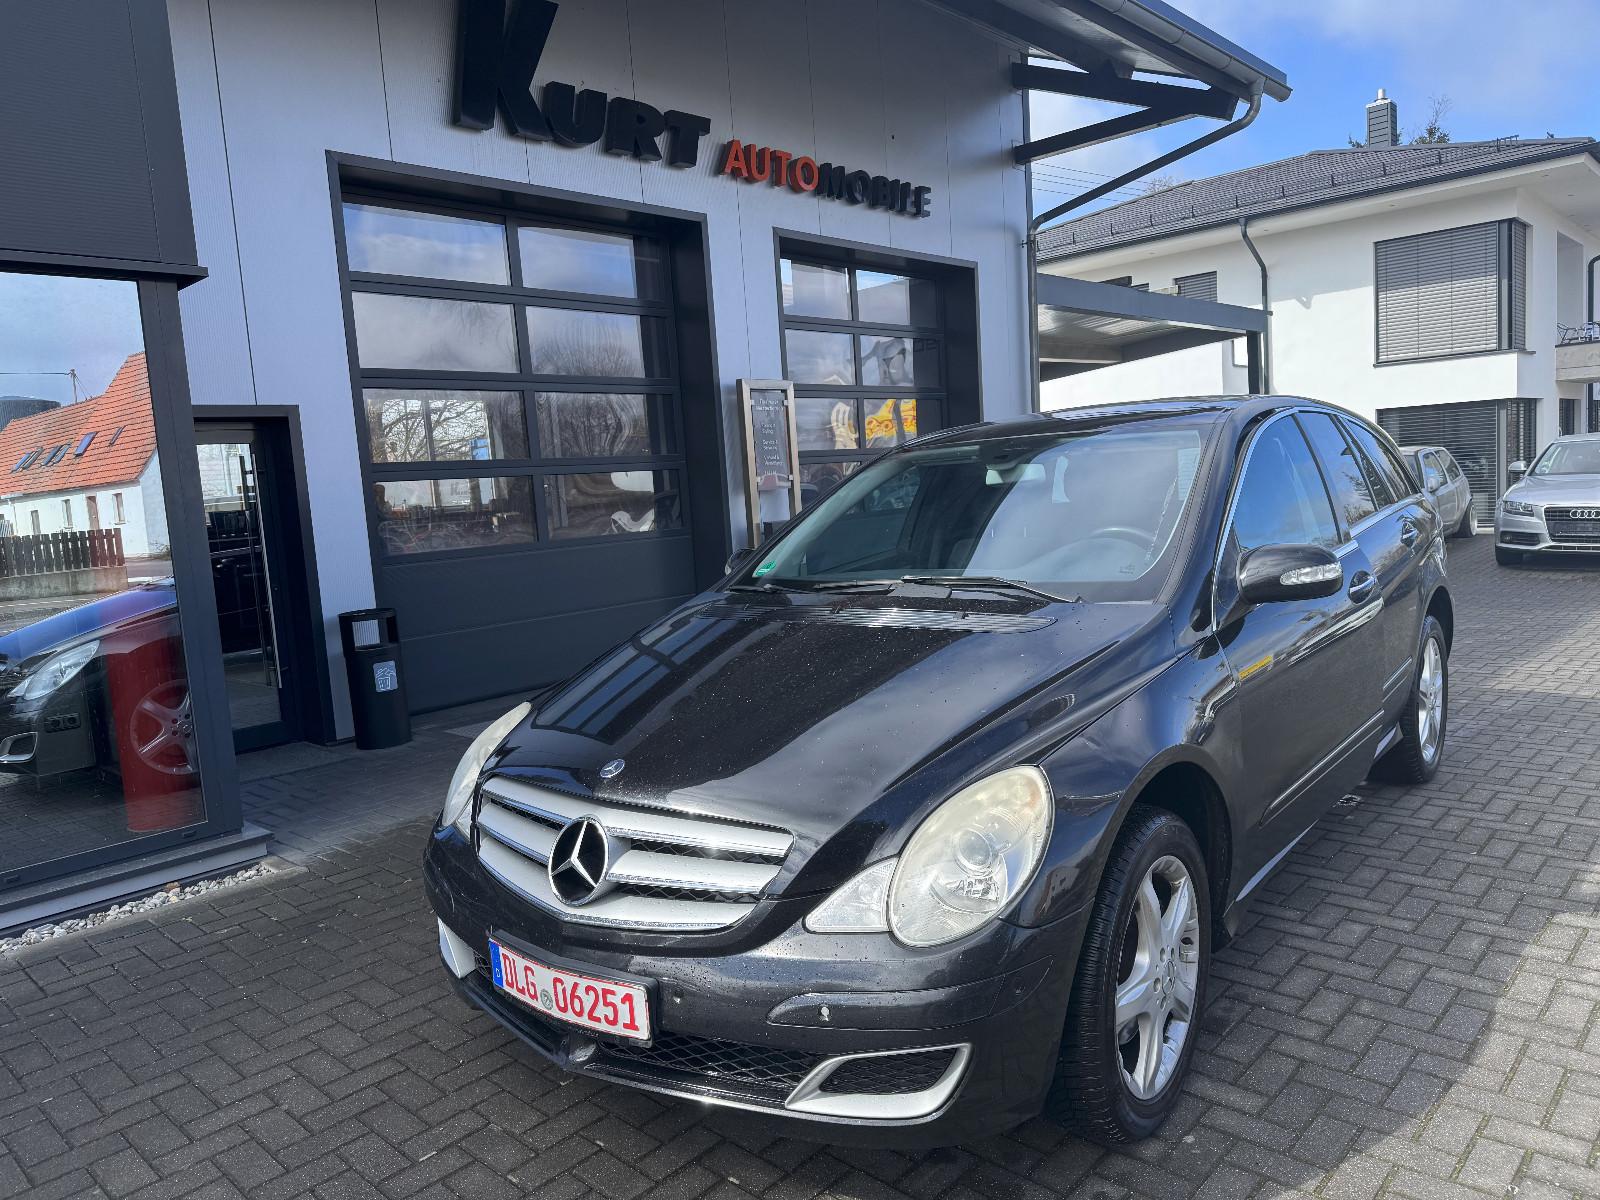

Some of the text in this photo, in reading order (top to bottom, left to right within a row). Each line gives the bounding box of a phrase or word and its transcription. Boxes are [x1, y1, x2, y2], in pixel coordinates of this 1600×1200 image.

[720, 139, 932, 218] AUTOMOBILE
[501, 952, 640, 1032] DLG 06251
